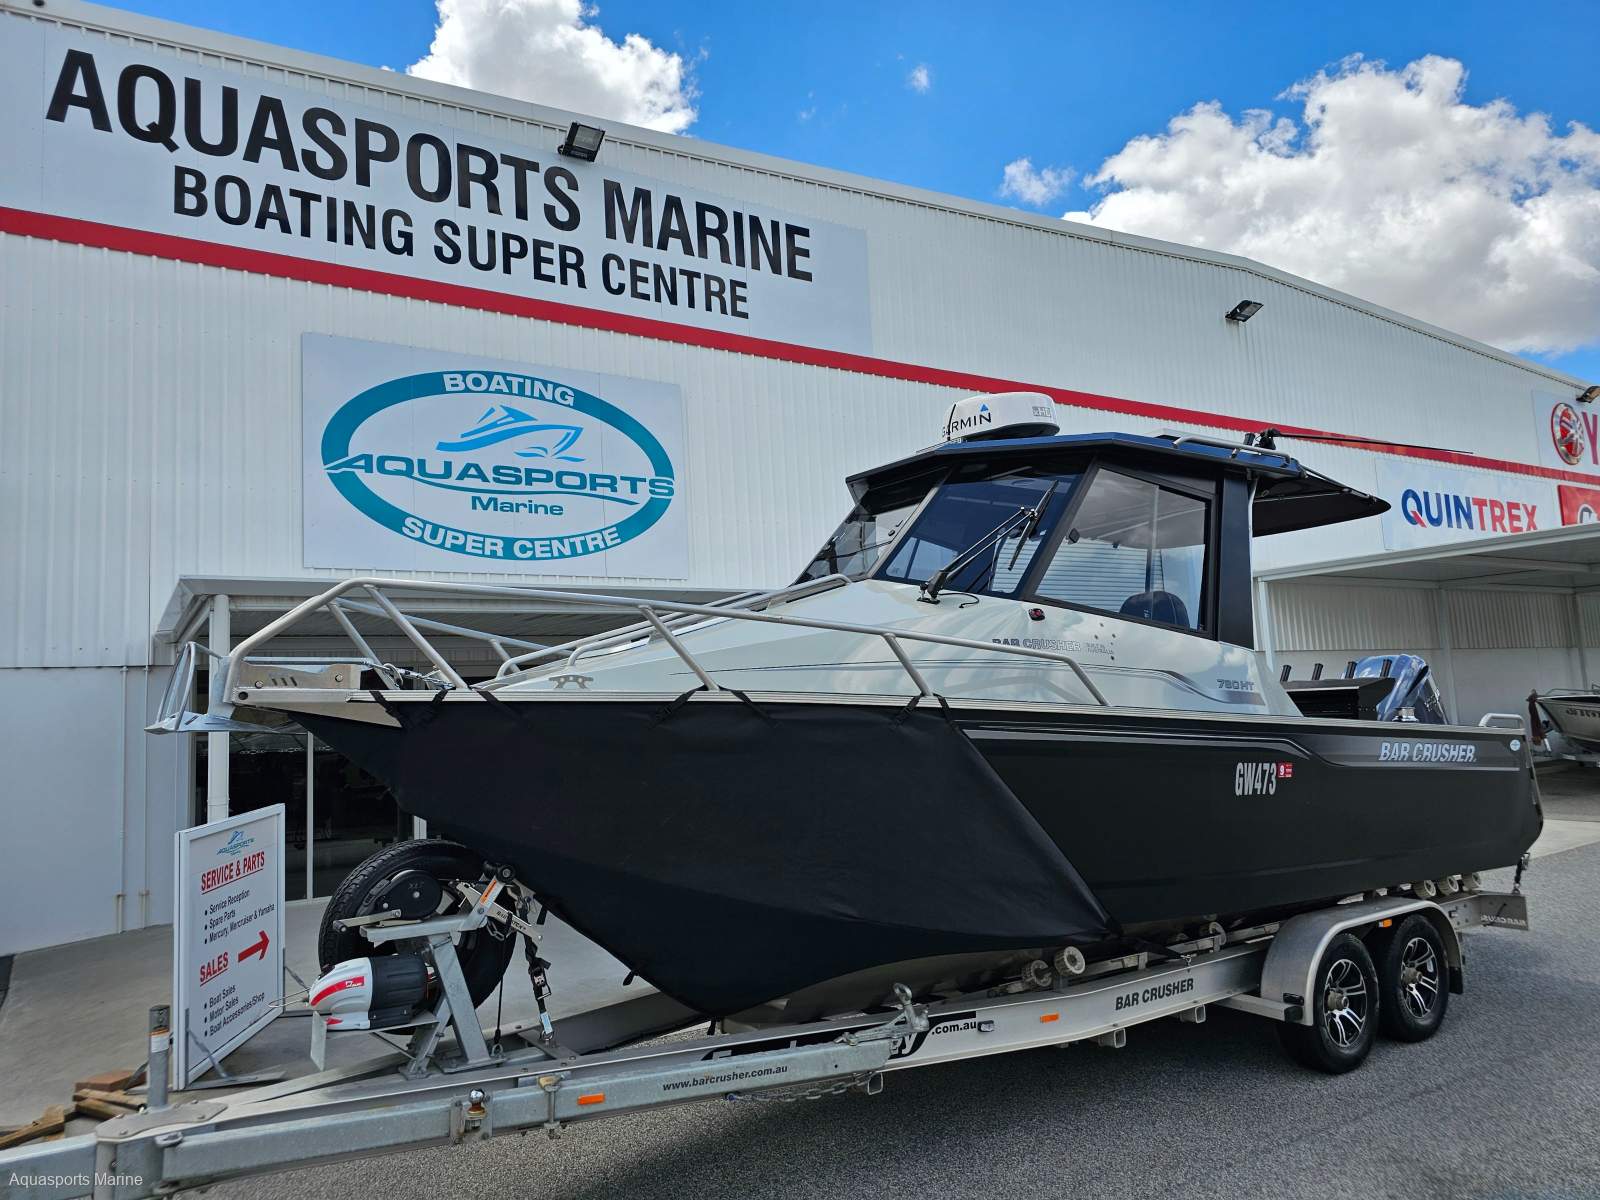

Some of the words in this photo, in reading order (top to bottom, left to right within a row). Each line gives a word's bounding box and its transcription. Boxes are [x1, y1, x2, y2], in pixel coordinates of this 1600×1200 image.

[46, 49, 580, 231] AQUASPORTS
[603, 178, 812, 282] MARINE
[174, 165, 413, 256] BOATING
[434, 218, 587, 289] SUPER
[602, 253, 749, 319] CENTRE
[443, 373, 575, 407] BOATING
[325, 454, 674, 497] AQUASPORTS
[471, 495, 564, 516] Marine
[1401, 489, 1538, 533] QUINTREX
[402, 517, 504, 558] SUPER
[513, 527, 621, 559] CENTRE
[1379, 742, 1410, 761] BAR
[1412, 743, 1476, 762] CRUSHER
[1235, 762, 1277, 796] GW473
[201, 862, 234, 891] SERVICE
[236, 860, 241, 877] &
[243, 851, 265, 873] PARTS
[209, 900, 227, 915] Service
[228, 889, 250, 905] Reception
[209, 916, 223, 930] Spare
[224, 909, 236, 922] Parts
[199, 951, 229, 982] SALES
[209, 993, 221, 1008] Boat
[222, 985, 236, 999] Sales
[209, 1005, 225, 1022] Motor
[225, 996, 239, 1011] Sales
[1115, 992, 1140, 1010] BAR
[1142, 978, 1194, 1003] CRUSHER
[209, 1021, 222, 1036] Boat
[662, 1064, 788, 1091] www.barcrusher.com.au
